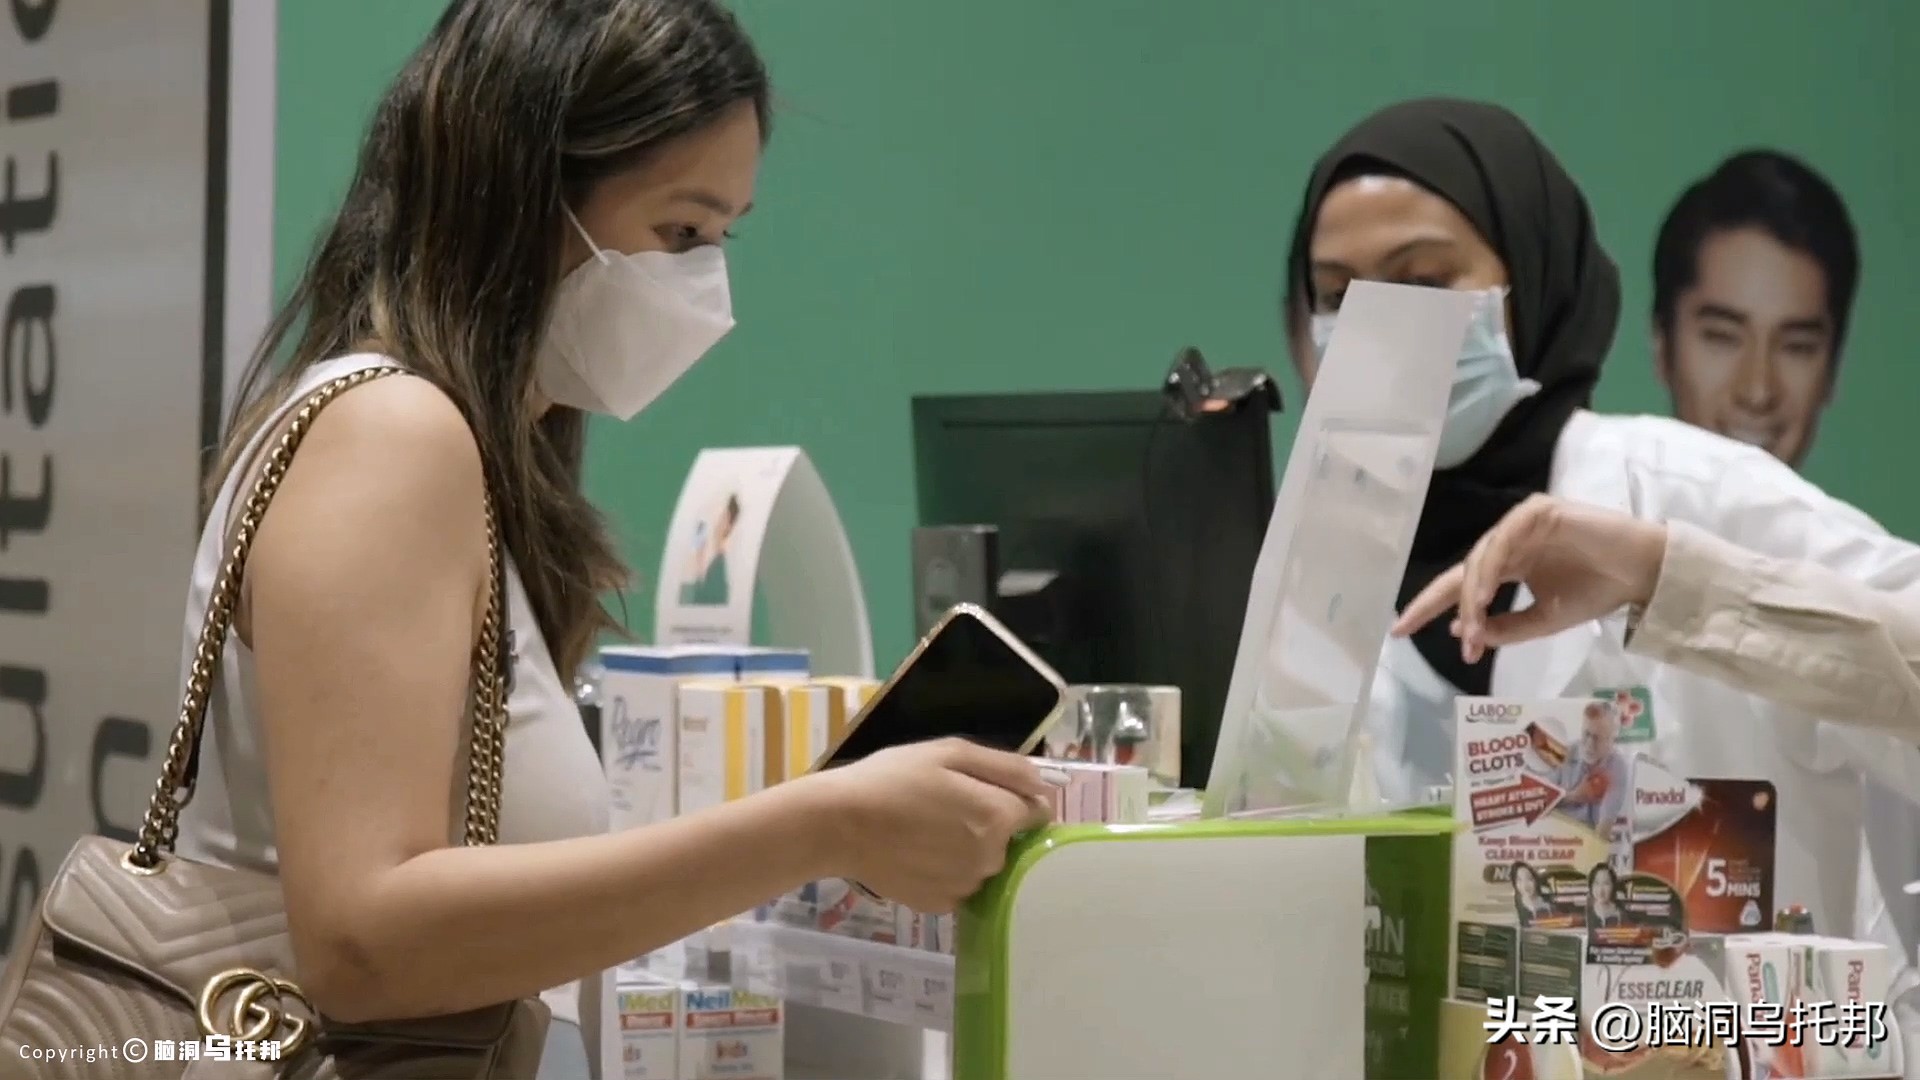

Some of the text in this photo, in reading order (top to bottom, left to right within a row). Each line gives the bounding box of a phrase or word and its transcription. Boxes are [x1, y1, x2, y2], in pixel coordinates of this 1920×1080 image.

[1467, 734, 1528, 756] BLOOD
[1469, 752, 1525, 774] CLOTS
[1635, 787, 1686, 804] Panadol
[1484, 848, 1524, 860] CLEAN
[1537, 848, 1576, 860] CLEAR
[1706, 858, 1727, 897] 5
[1726, 882, 1761, 898] MINS
